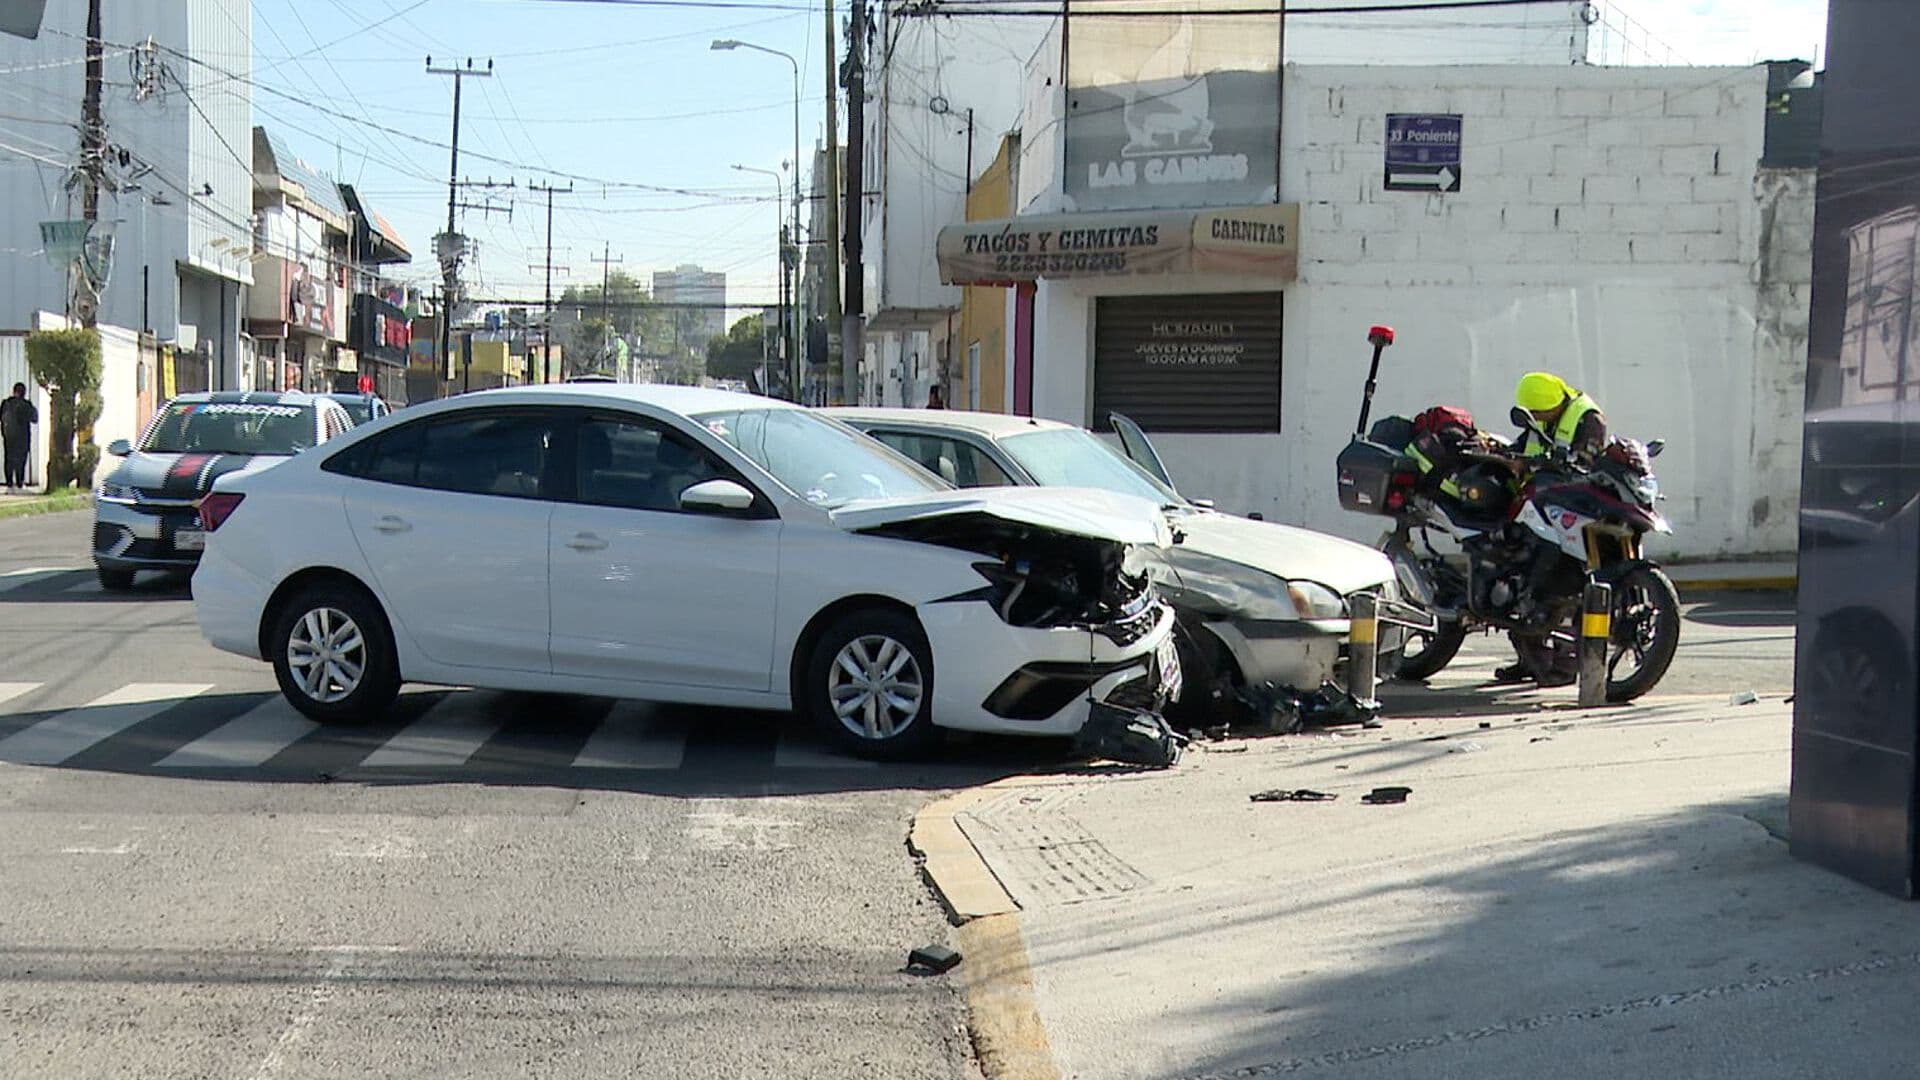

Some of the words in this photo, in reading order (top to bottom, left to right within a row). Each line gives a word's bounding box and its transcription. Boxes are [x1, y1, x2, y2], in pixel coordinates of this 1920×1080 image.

[1407, 129, 1460, 143] Poniente
[1088, 160, 1137, 188] LAS
[1037, 231, 1053, 252] Y
[1211, 218, 1286, 245] CARNITAS
